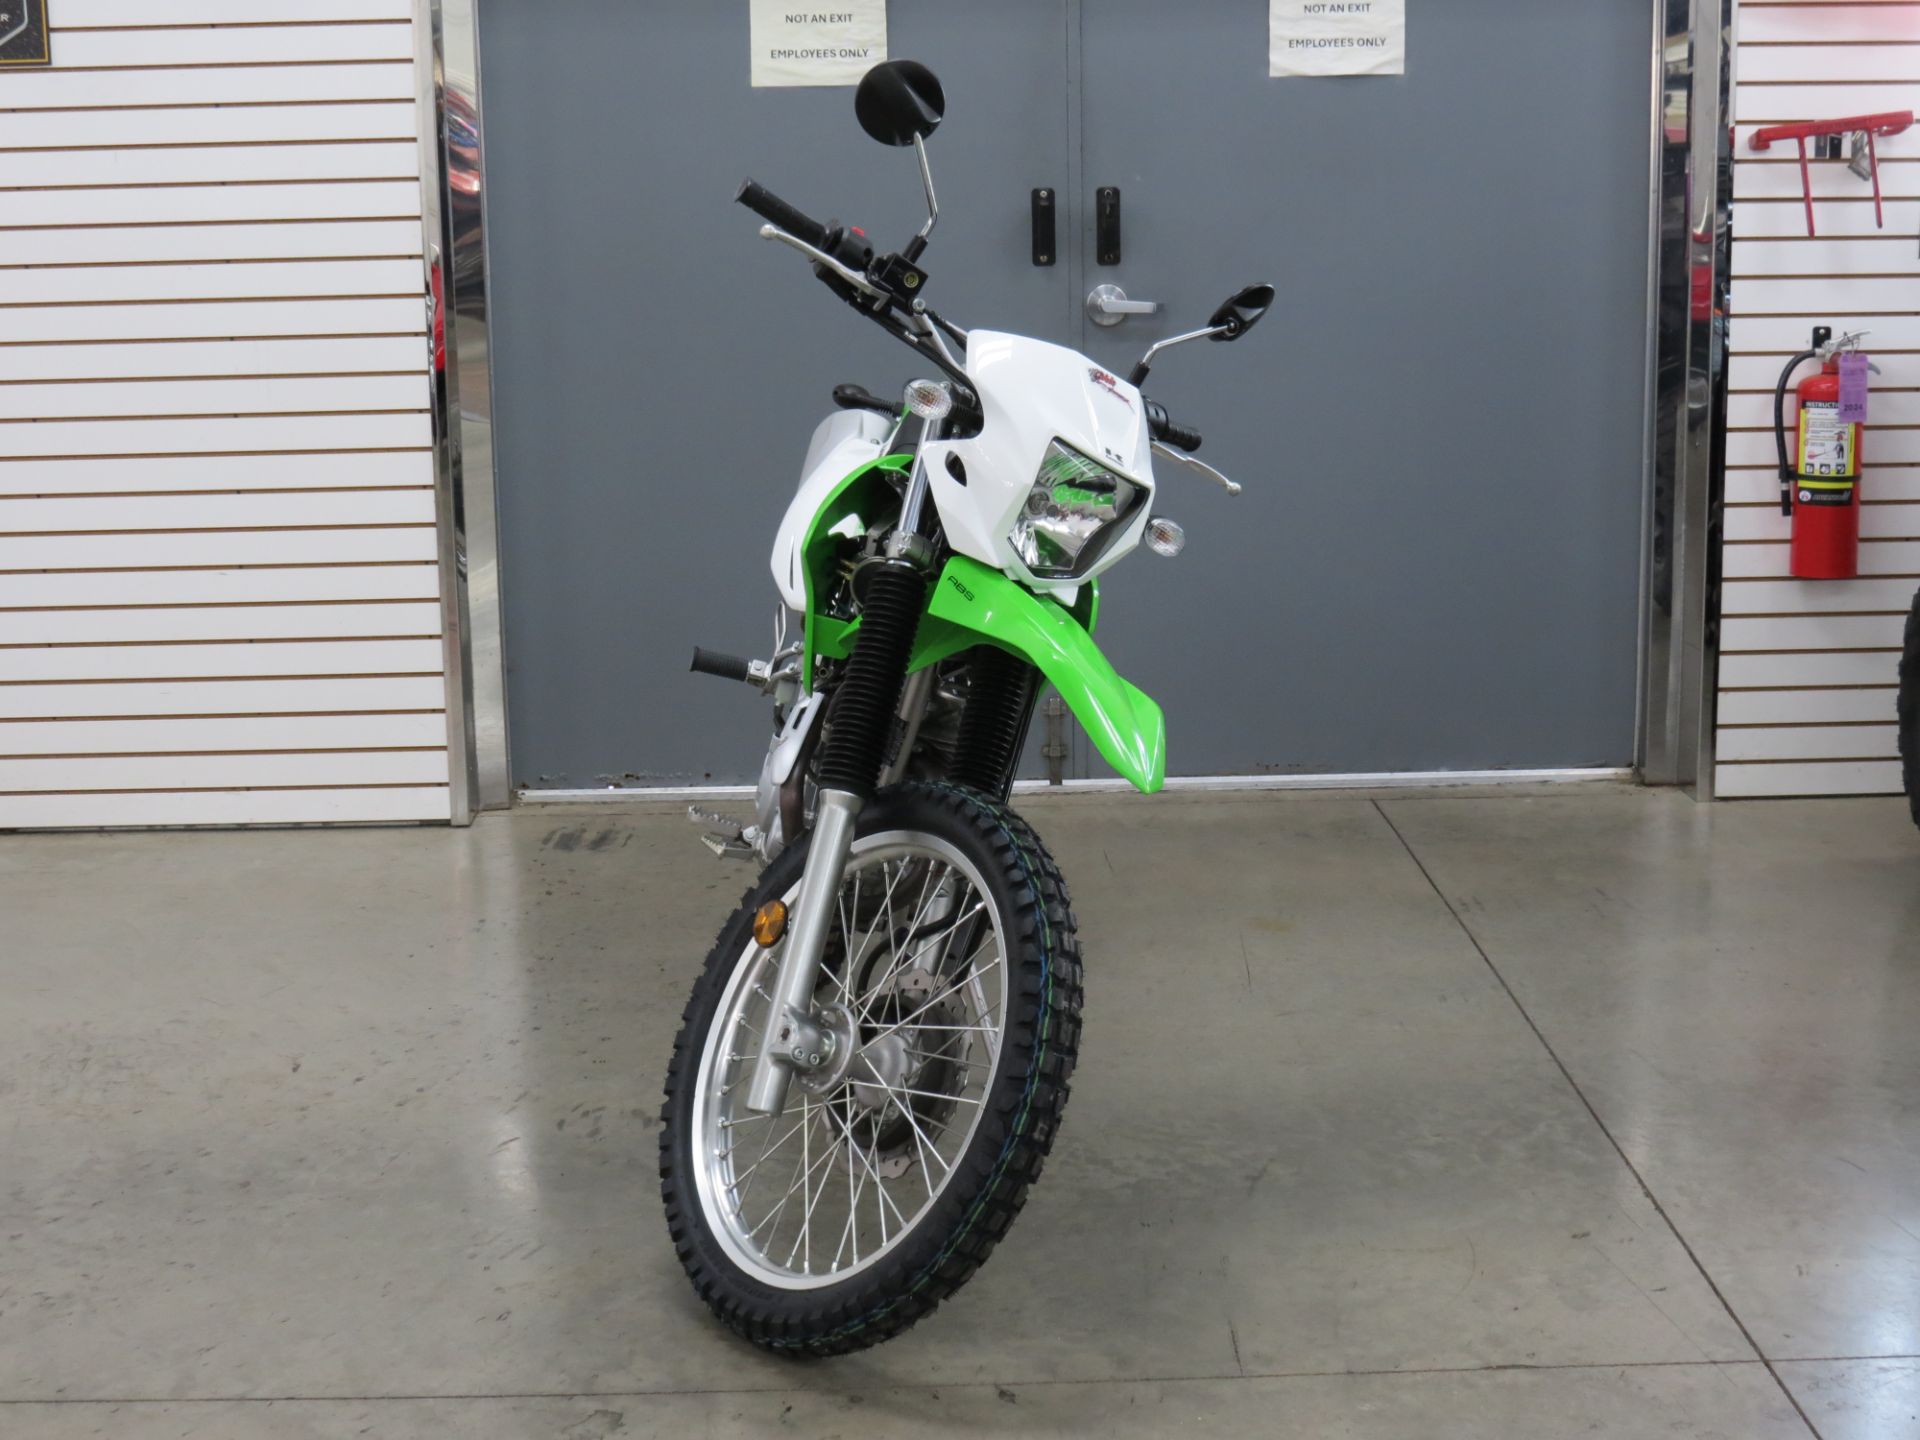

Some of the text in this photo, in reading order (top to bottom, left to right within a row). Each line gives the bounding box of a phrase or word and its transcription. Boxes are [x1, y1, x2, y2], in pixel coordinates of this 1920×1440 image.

[1304, 3, 1371, 13] NOT AN EXIT
[785, 14, 853, 23] NOT AN EXIT
[1288, 38, 1386, 48] EMPLOYEES ONLY
[770, 49, 869, 59] EMPLOYEES ONLY
[947, 575, 975, 601] ABS
